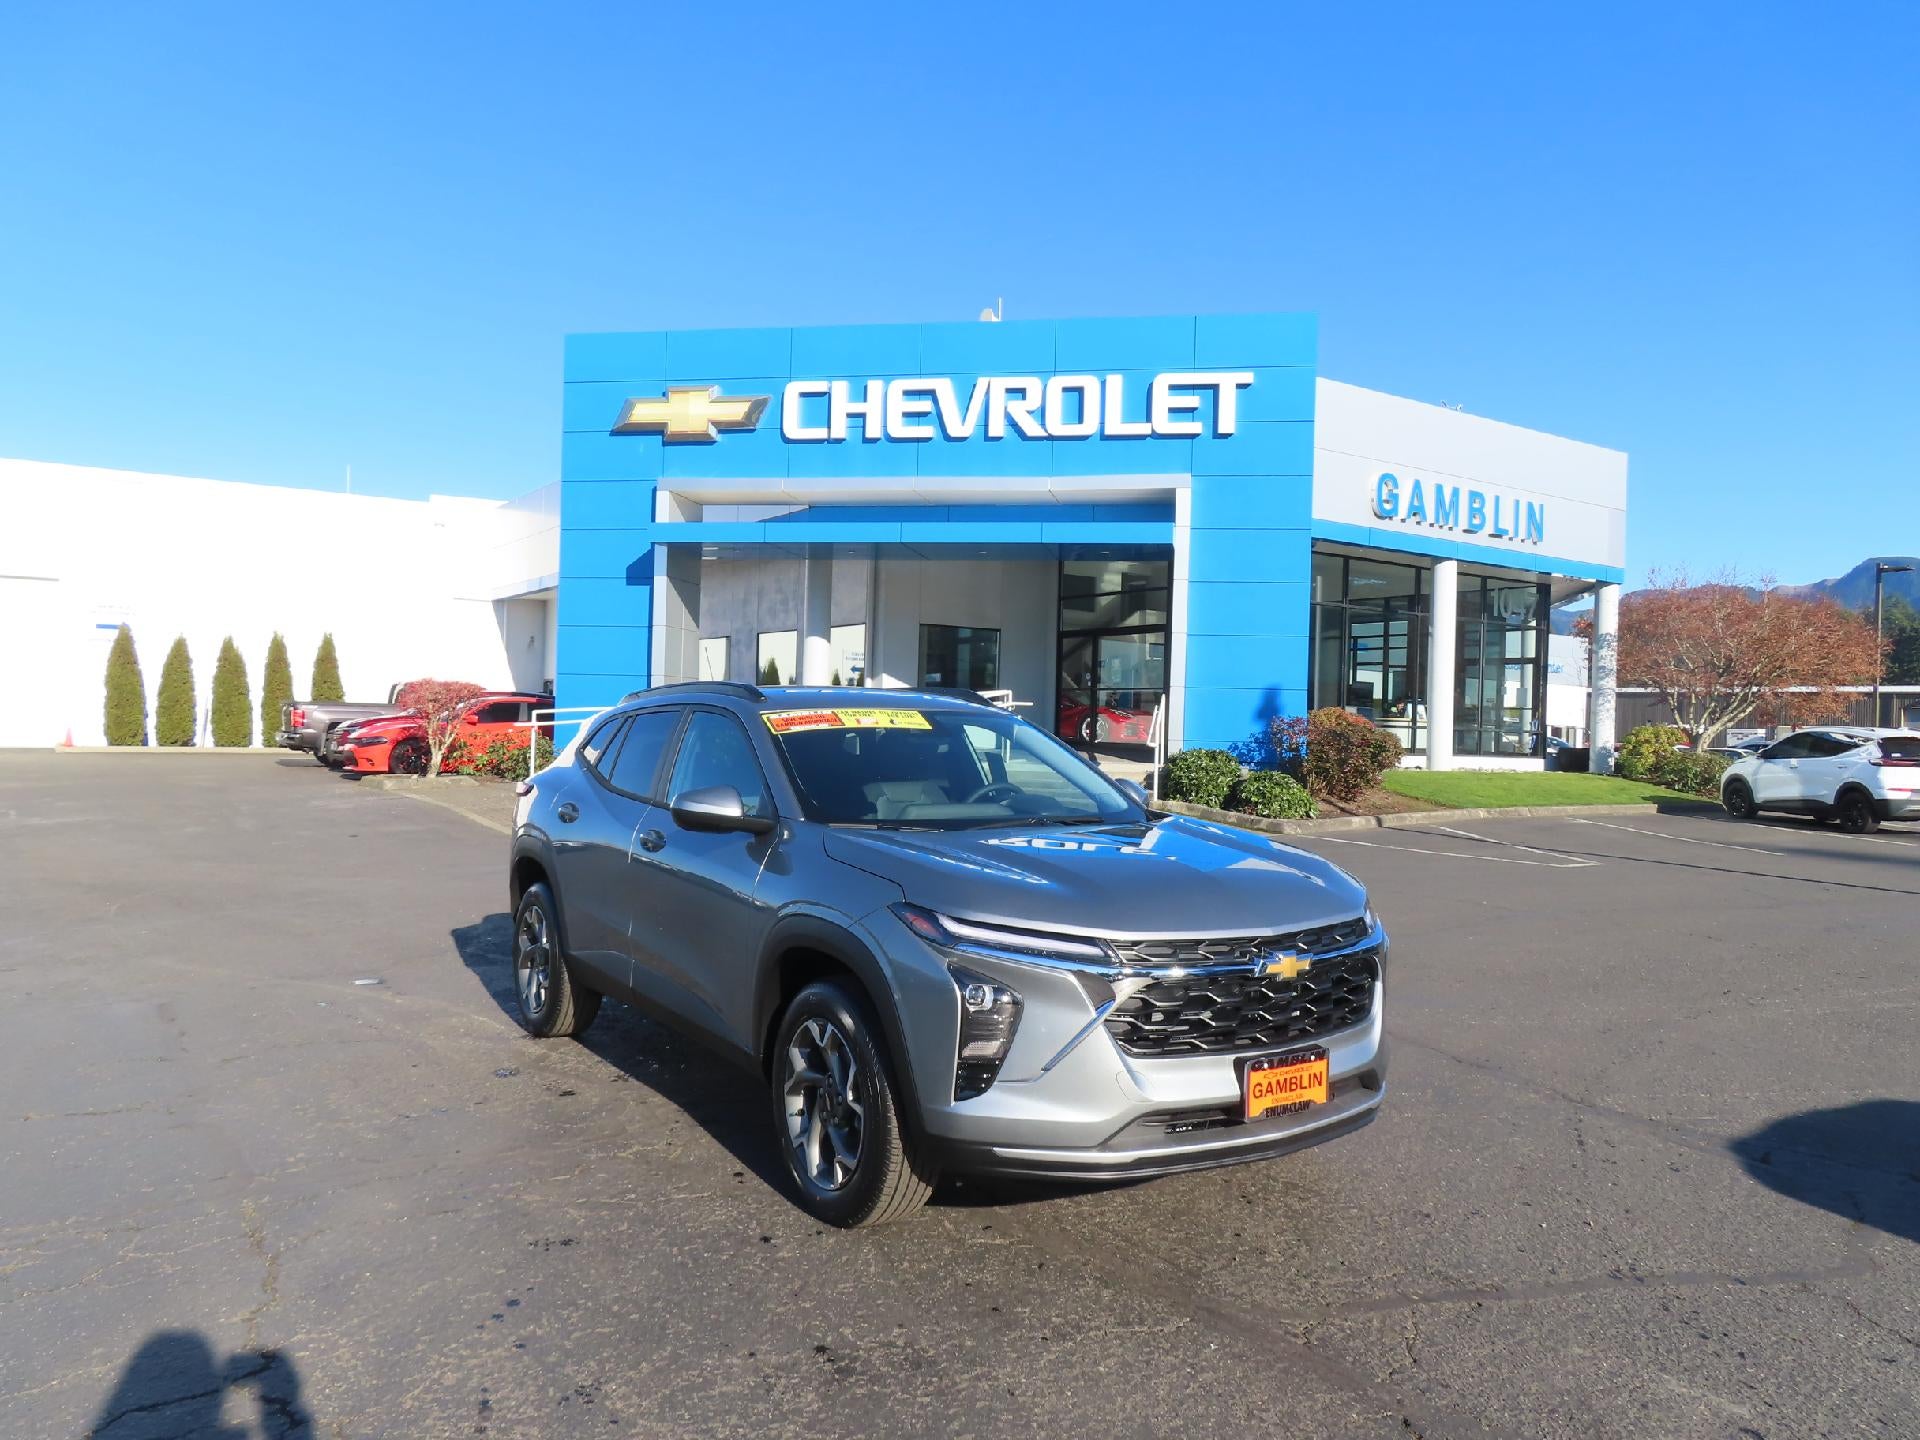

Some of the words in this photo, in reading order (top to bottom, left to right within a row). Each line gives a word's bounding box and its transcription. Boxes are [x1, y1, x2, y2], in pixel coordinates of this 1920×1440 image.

[782, 372, 1254, 439] CHEVROLET
[1371, 472, 1545, 543] GAMBLIN
[1252, 1071, 1323, 1099] GAMBLIN
[1264, 1100, 1311, 1118] ENUMCLAW
